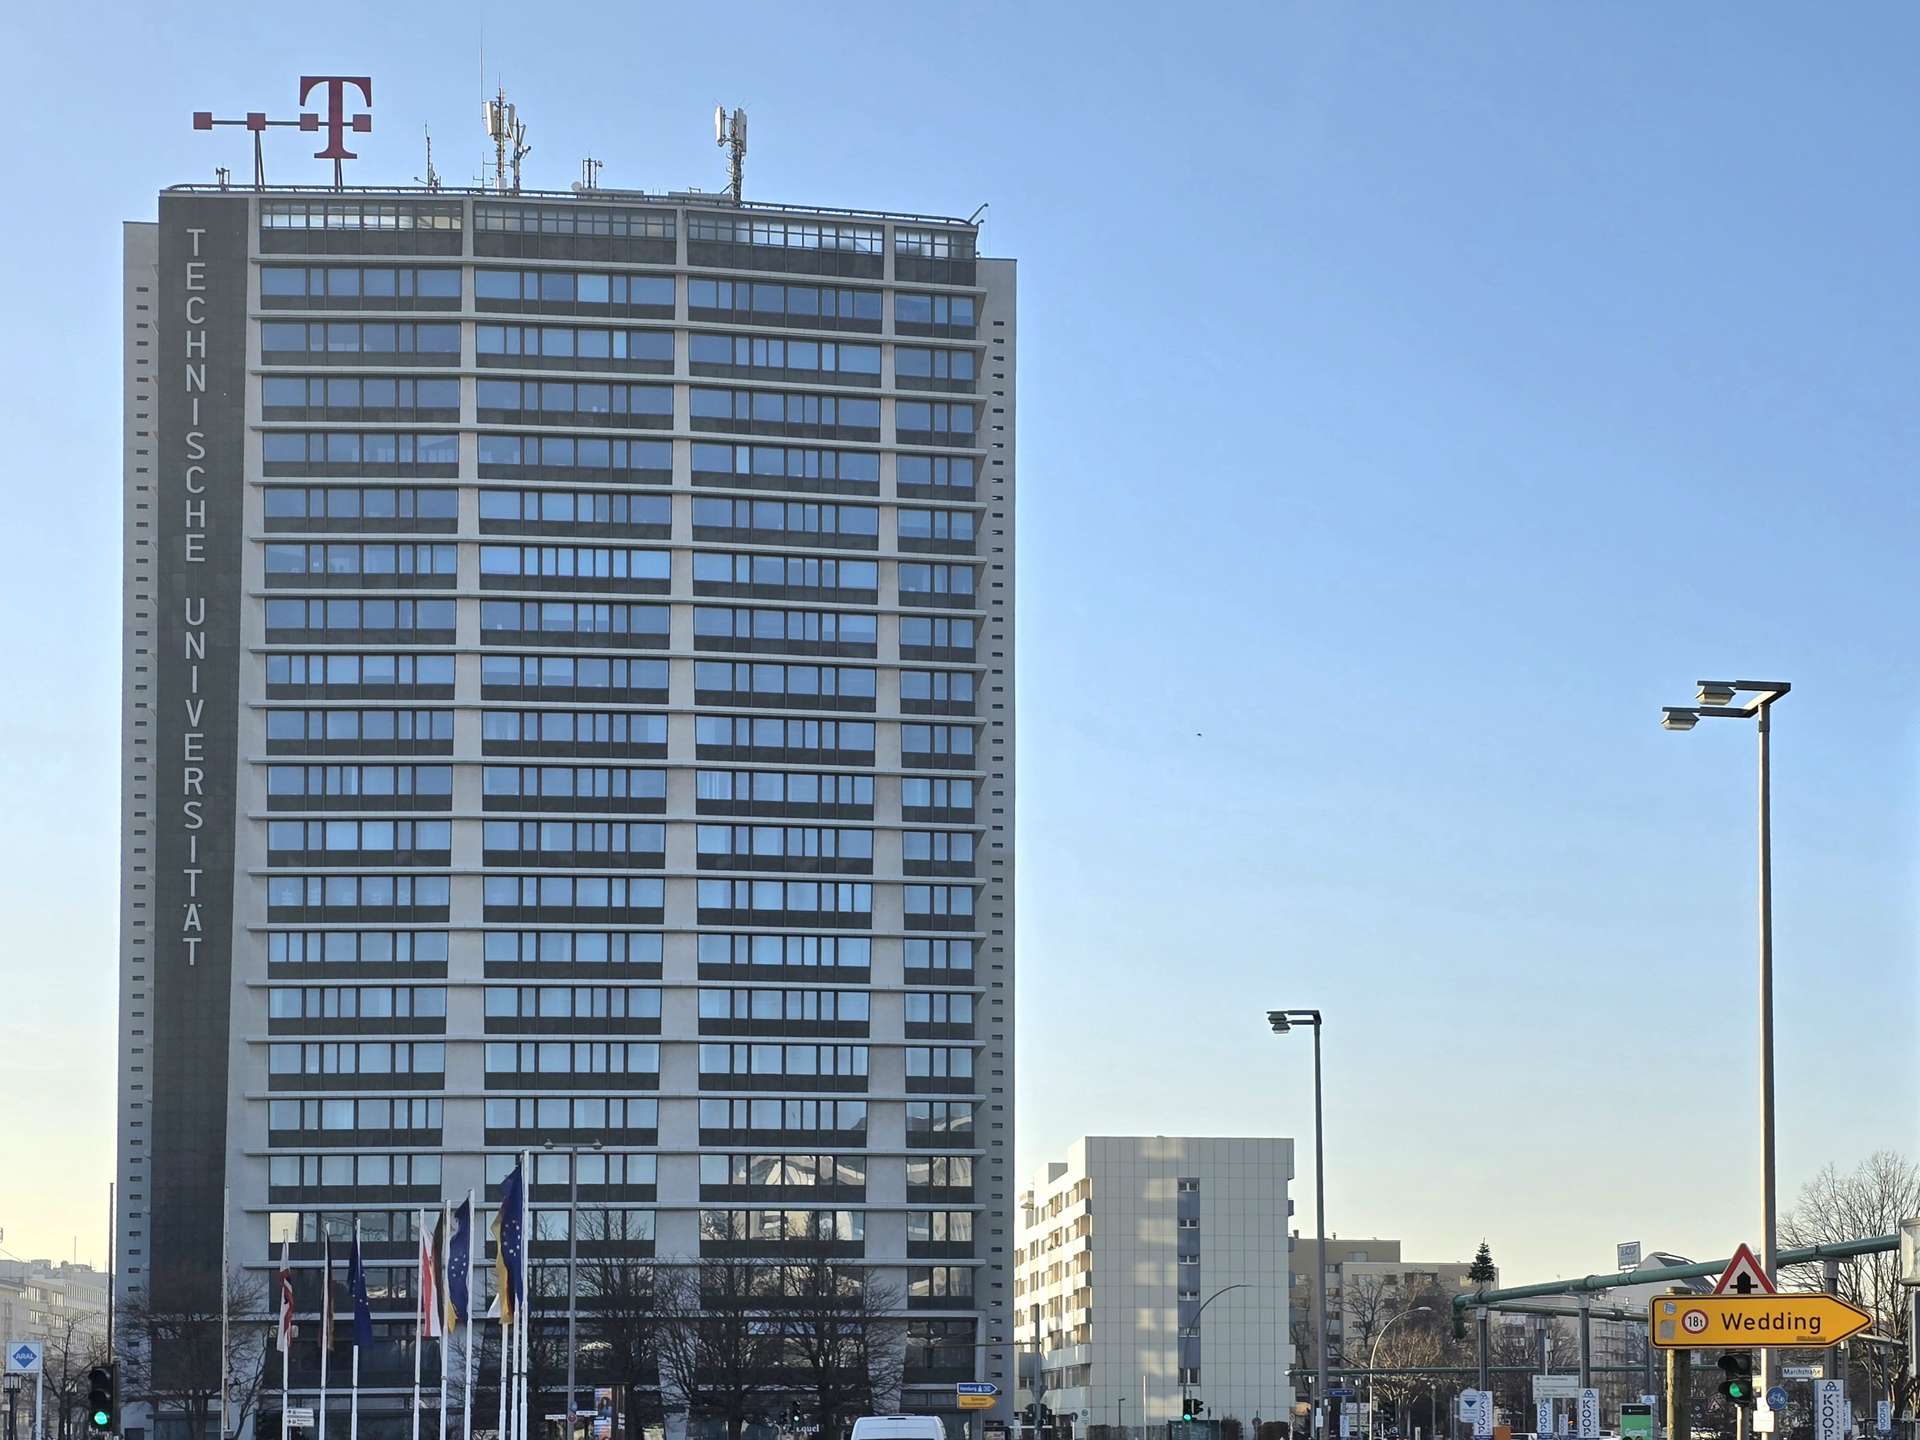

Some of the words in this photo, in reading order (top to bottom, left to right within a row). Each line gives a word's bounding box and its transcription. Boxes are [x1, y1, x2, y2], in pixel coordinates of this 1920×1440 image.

[300, 76, 372, 159] T
[185, 228, 206, 562] TECHNISCHE
[183, 597, 205, 966] UNIVERSITÄT
[1721, 1312, 1821, 1334] Wedding
